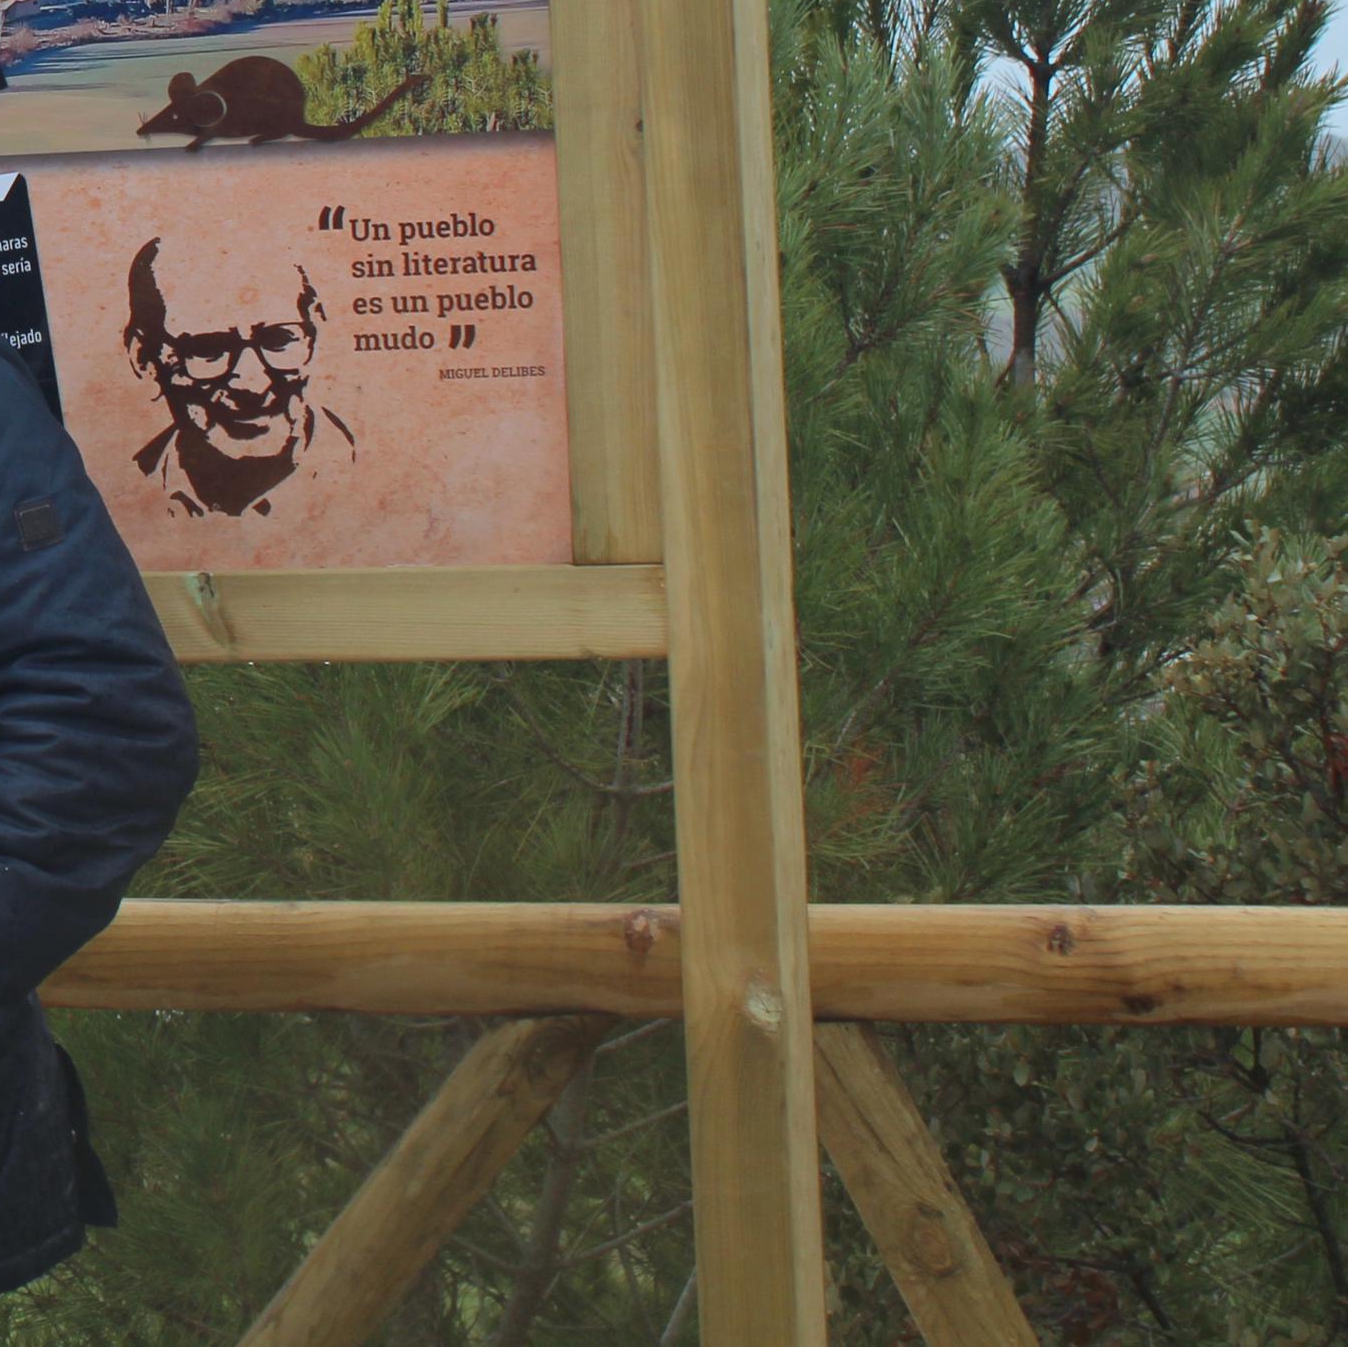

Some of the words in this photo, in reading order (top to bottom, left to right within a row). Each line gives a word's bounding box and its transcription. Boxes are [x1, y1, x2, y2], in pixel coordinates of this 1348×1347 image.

[398, 212, 495, 246] pueblo
[1, 257, 32, 276] sería
[351, 253, 395, 278] sin
[402, 251, 537, 277] literatura
[352, 296, 383, 315] es
[391, 296, 429, 314] un
[436, 285, 534, 318] pueblo
[439, 367, 489, 380] MIGUEL
[491, 365, 546, 378] DELIBES
